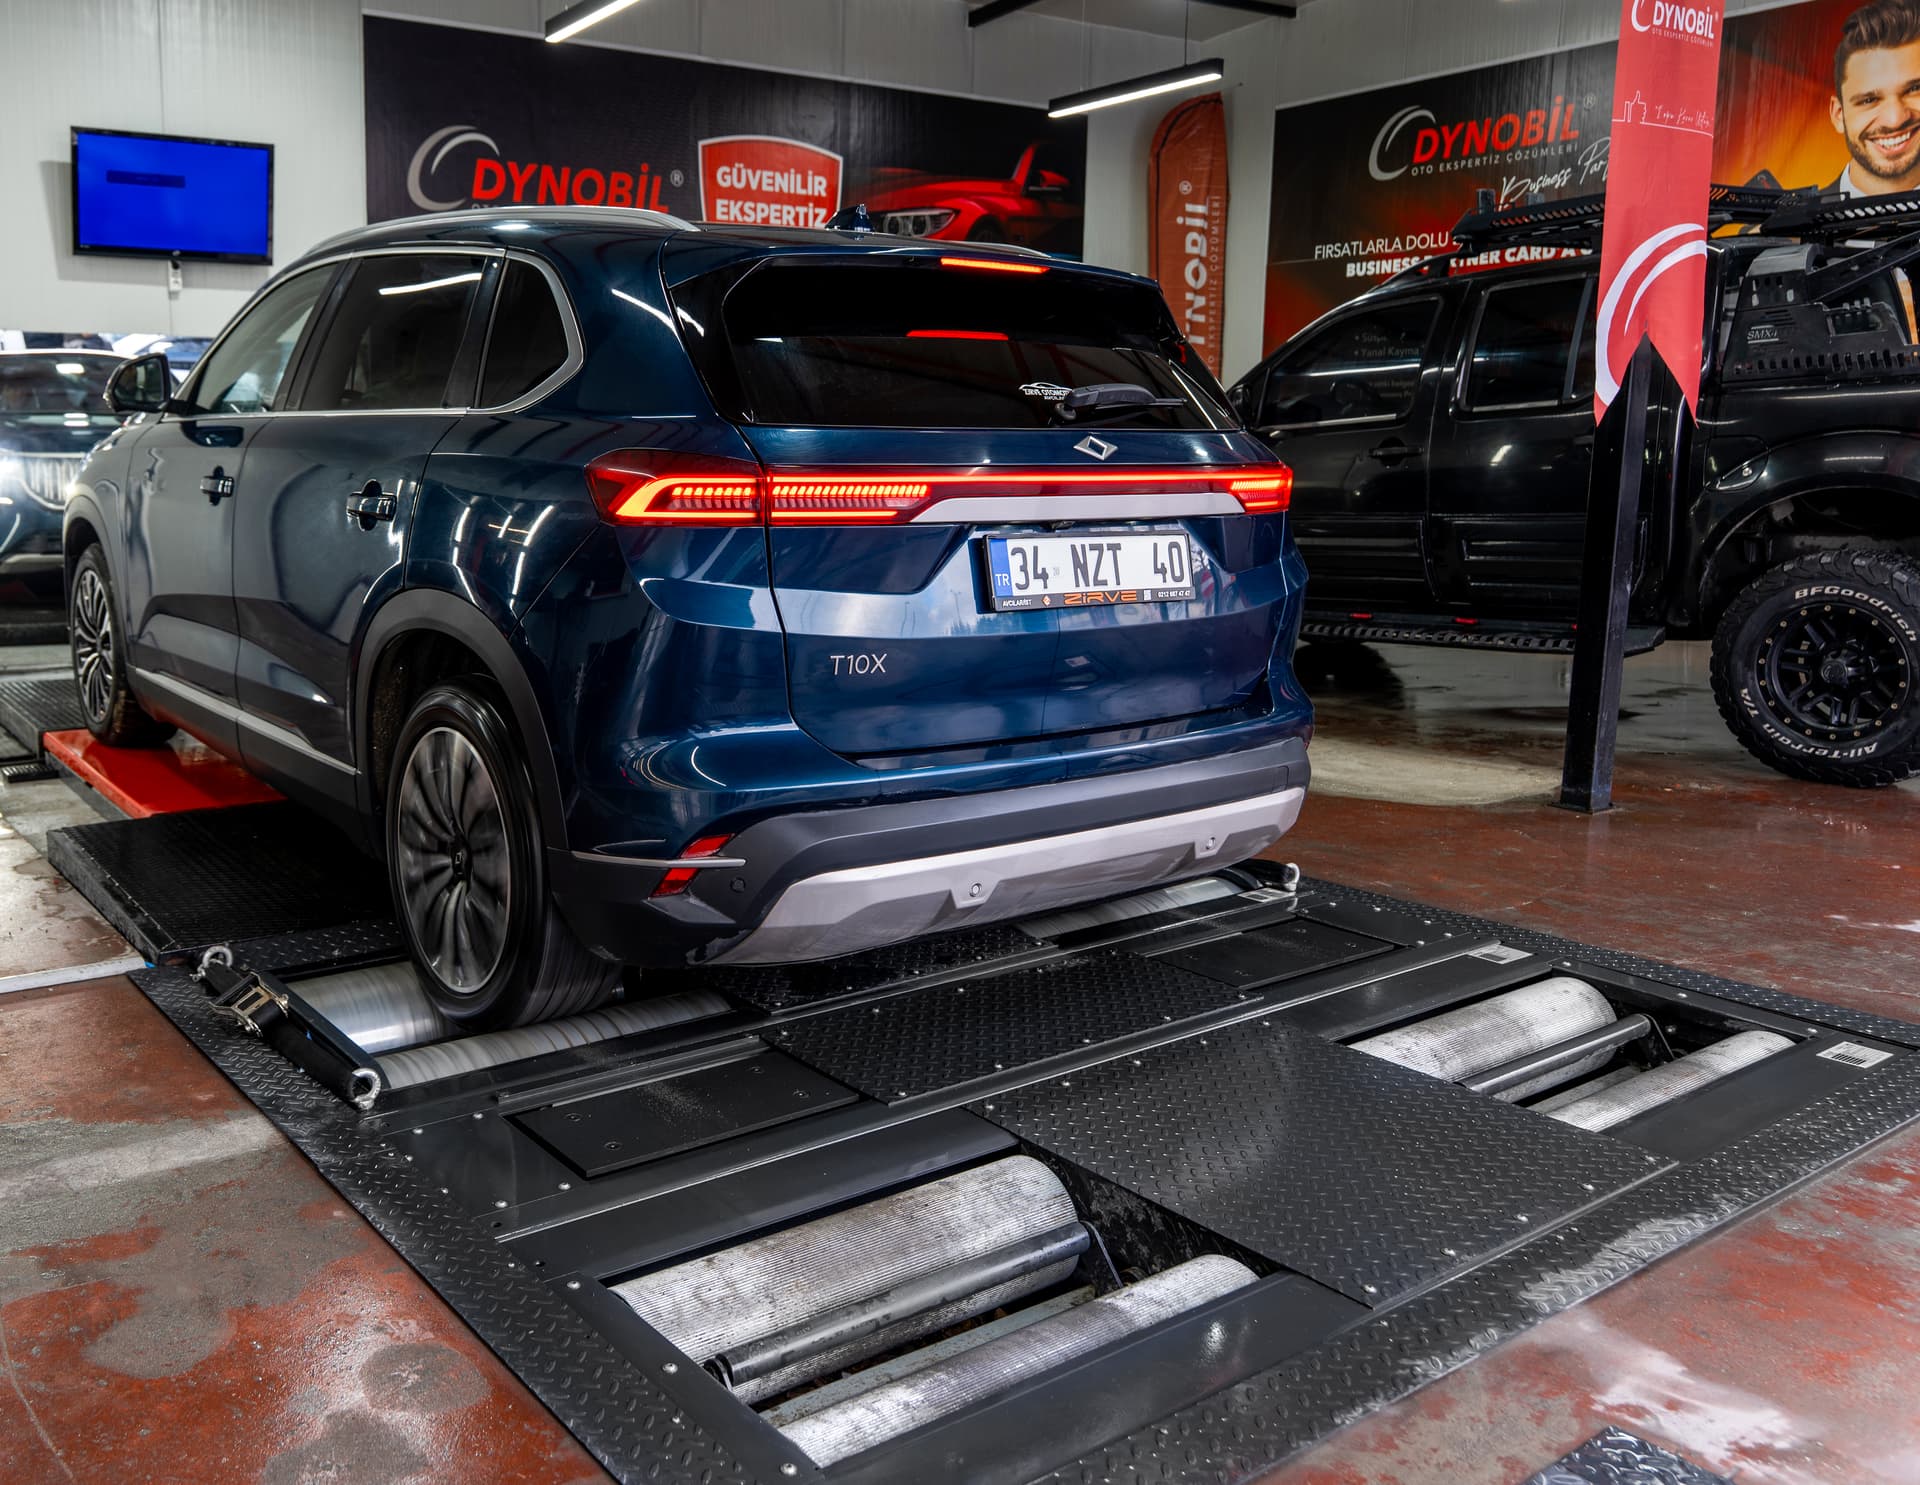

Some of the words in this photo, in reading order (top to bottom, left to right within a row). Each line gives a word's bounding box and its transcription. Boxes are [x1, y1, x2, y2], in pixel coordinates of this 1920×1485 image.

[1652, 0, 1715, 39] DYNOBİL
[1412, 96, 1580, 165] DYNOBİL
[1411, 164, 1433, 177] OTO
[1439, 153, 1501, 173] EKSPERTİZ
[1505, 142, 1579, 164] ÇÖZÜMLERİ
[471, 157, 670, 215] DYNOBİL
[716, 162, 827, 198] GÜVENİLİR
[1498, 164, 1573, 212] Business
[716, 198, 828, 229] EKSPERTİZ
[1314, 237, 1402, 260] FIRSATLARLA
[1406, 231, 1450, 251] DOLU
[995, 573, 1010, 587] TR
[1010, 545, 1050, 591] 34
[1070, 542, 1122, 589] NZT
[1152, 541, 1186, 584] 40
[1794, 585, 1918, 642] BFGoodrich
[830, 653, 888, 676] T10X
[1740, 687, 1760, 718] T/A
[1762, 722, 1879, 760] All-Terrain
